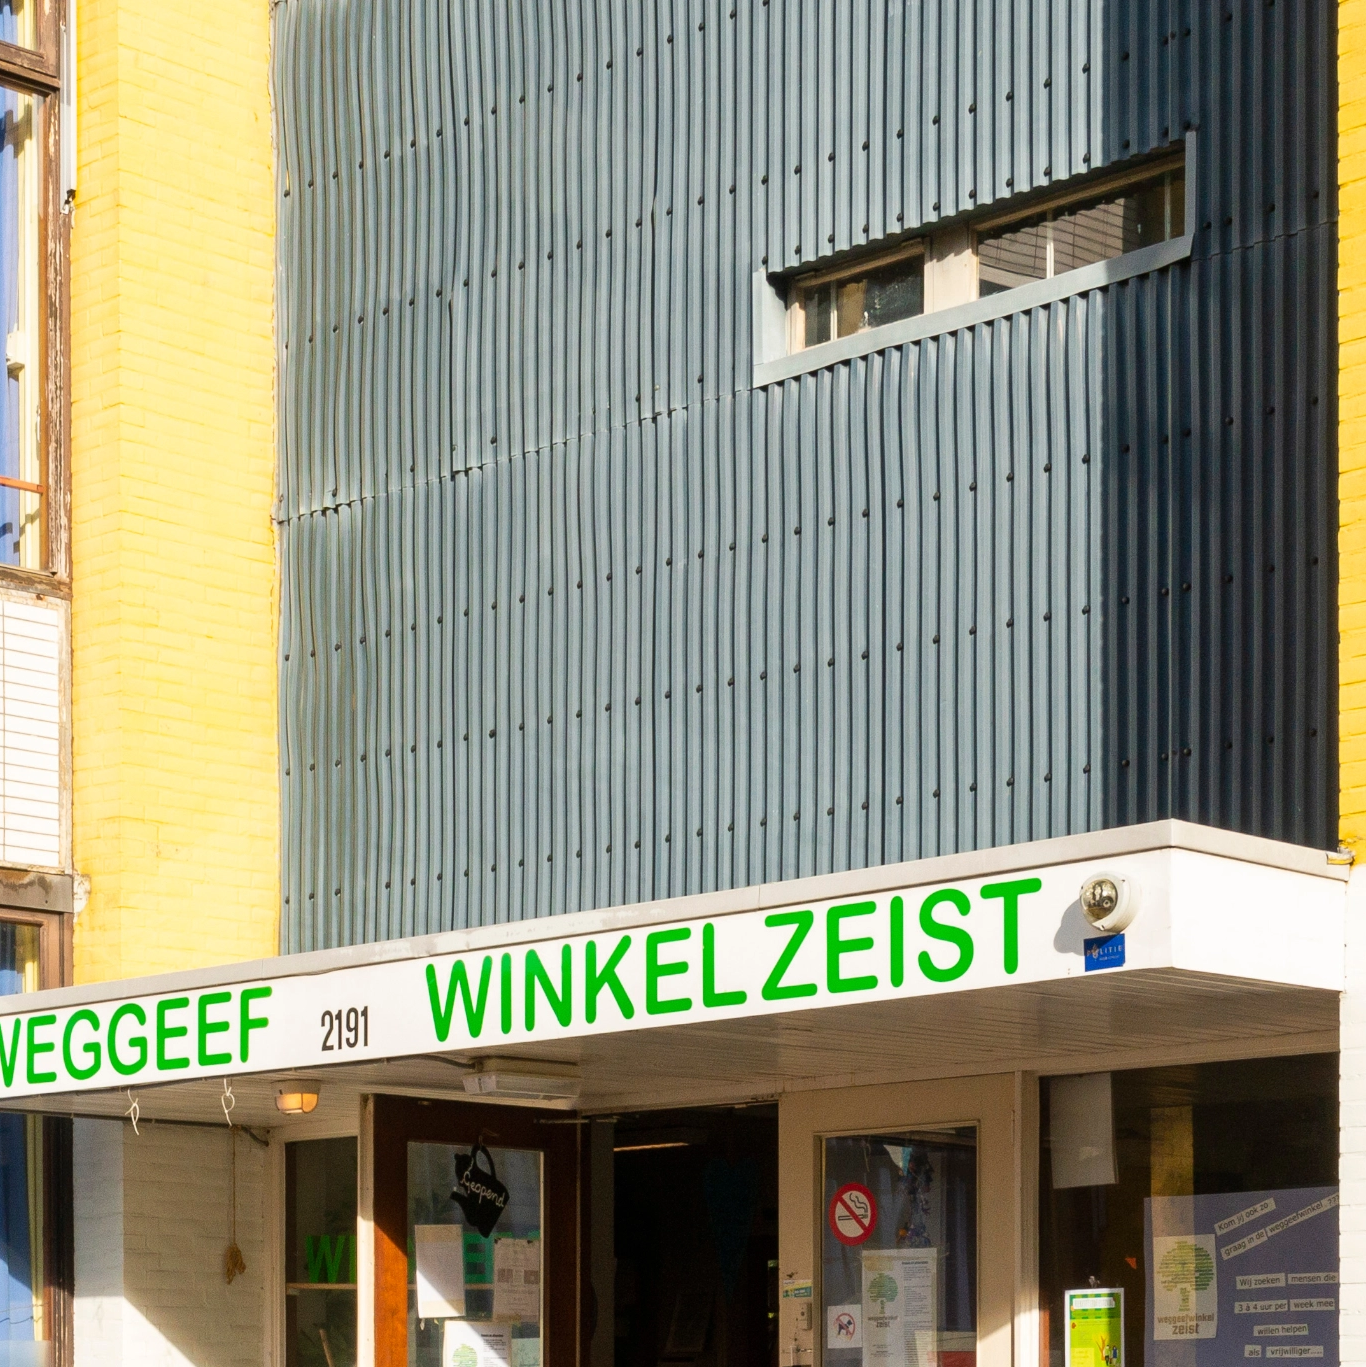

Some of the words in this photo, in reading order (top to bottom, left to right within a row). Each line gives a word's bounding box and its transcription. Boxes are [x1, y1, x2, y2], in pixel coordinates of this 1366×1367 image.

[320, 1006, 370, 1052] 2191
[460, 1171, 505, 1207] Geopend
[1217, 1218, 1236, 1231] Kom
[1236, 1212, 1245, 1225] jij
[1245, 1208, 1259, 1219] ook
[1259, 1202, 1269, 1211] zo
[1224, 1239, 1246, 1256] graag
[1247, 1236, 1255, 1246] in
[1255, 1231, 1265, 1241] de
[1268, 1200, 1324, 1233] weggeefwinkel
[1239, 1278, 1253, 1287] Wij
[1253, 1276, 1281, 1286] zoeken
[1291, 1275, 1322, 1283] mensen
[1323, 1273, 1337, 1282] die
[1252, 1303, 1258, 1311] 4
[1259, 1303, 1273, 1311] uur
[1274, 1303, 1287, 1312] per
[1293, 1299, 1315, 1309] week
[1316, 1300, 1334, 1308] mee
[1157, 1313, 1215, 1325] weggeefwinkel
[1171, 1323, 1200, 1335] zeist
[1257, 1325, 1280, 1335] willen
[1281, 1324, 1308, 1336] helpen
[1248, 1348, 1260, 1357] als
